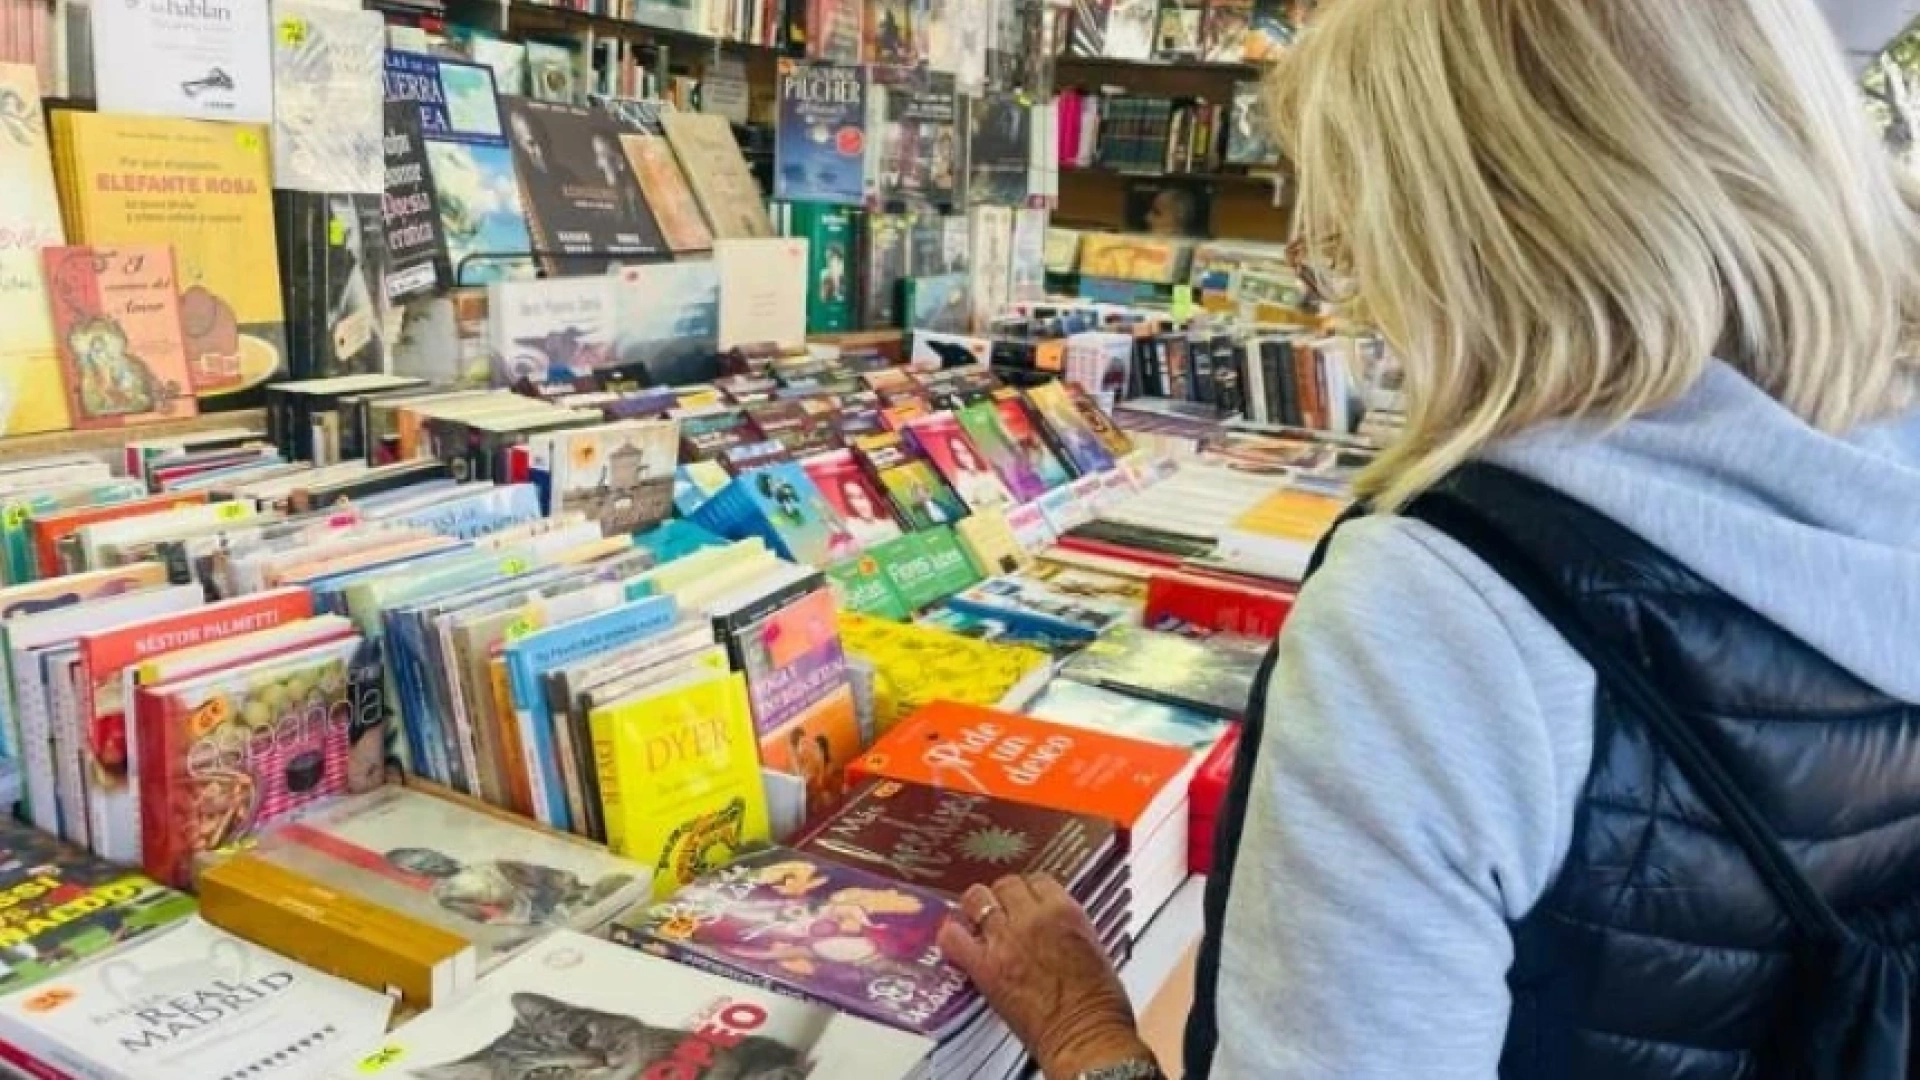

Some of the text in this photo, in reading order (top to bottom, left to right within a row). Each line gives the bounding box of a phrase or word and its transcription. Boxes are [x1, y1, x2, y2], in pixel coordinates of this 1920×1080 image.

[785, 78, 861, 103] PILCHER
[97, 173, 258, 194] ELEFANTE ROSA
[134, 609, 279, 653] NÉSTOR PALMETTI
[644, 719, 733, 772] DYER
[921, 721, 1003, 778] Pide
[989, 735, 1031, 761] un
[1005, 734, 1075, 786] deseo
[597, 740, 619, 804] DYER
[119, 971, 294, 1051] MADRID
[136, 979, 236, 1025] REAL
